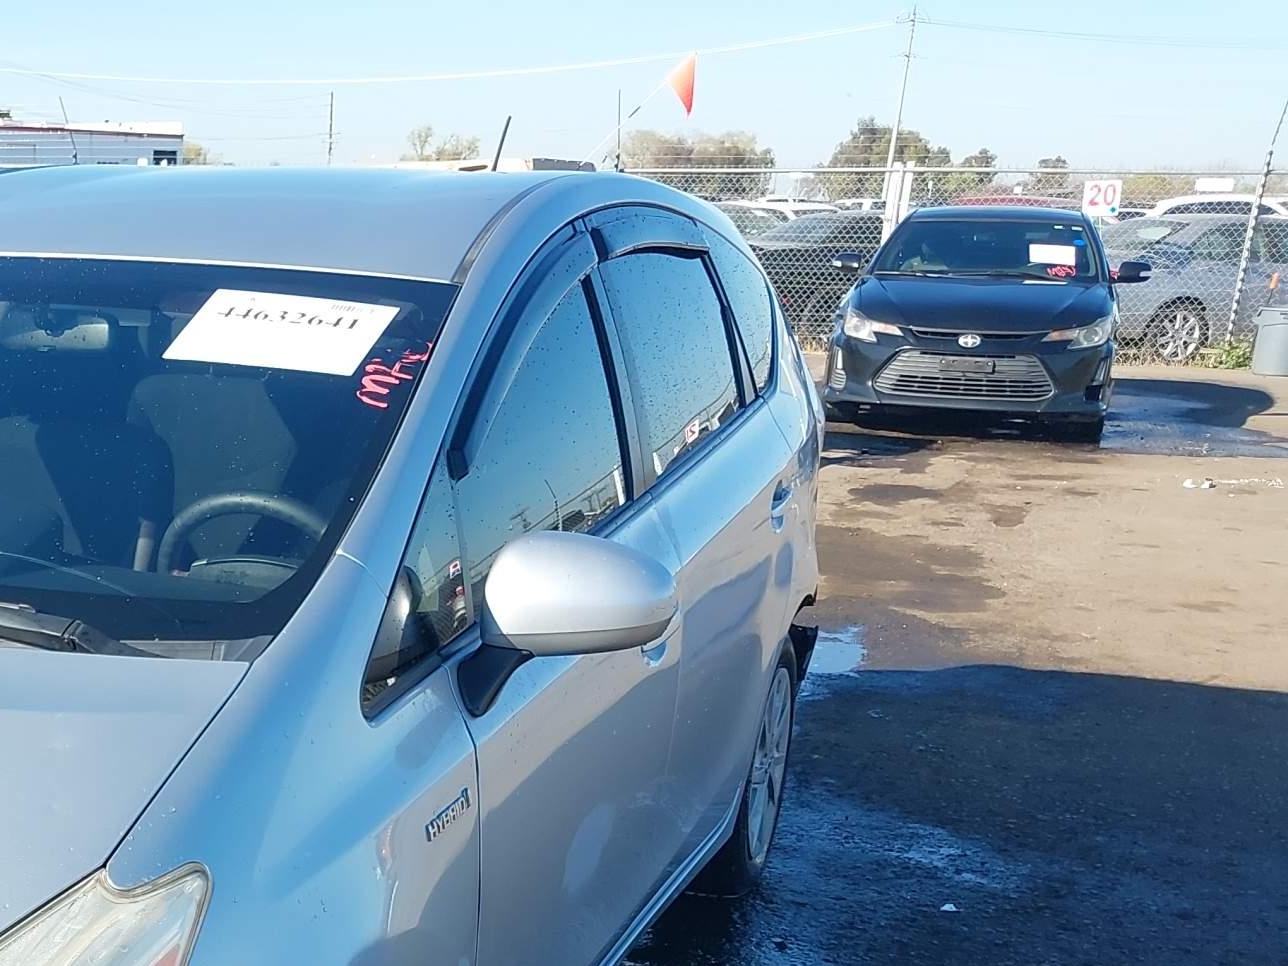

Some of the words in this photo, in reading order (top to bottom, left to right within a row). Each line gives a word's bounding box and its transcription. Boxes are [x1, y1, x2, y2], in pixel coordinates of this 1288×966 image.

[1088, 184, 1116, 206] 20
[217, 307, 359, 330] 44632641
[426, 790, 470, 841] HYBRID
